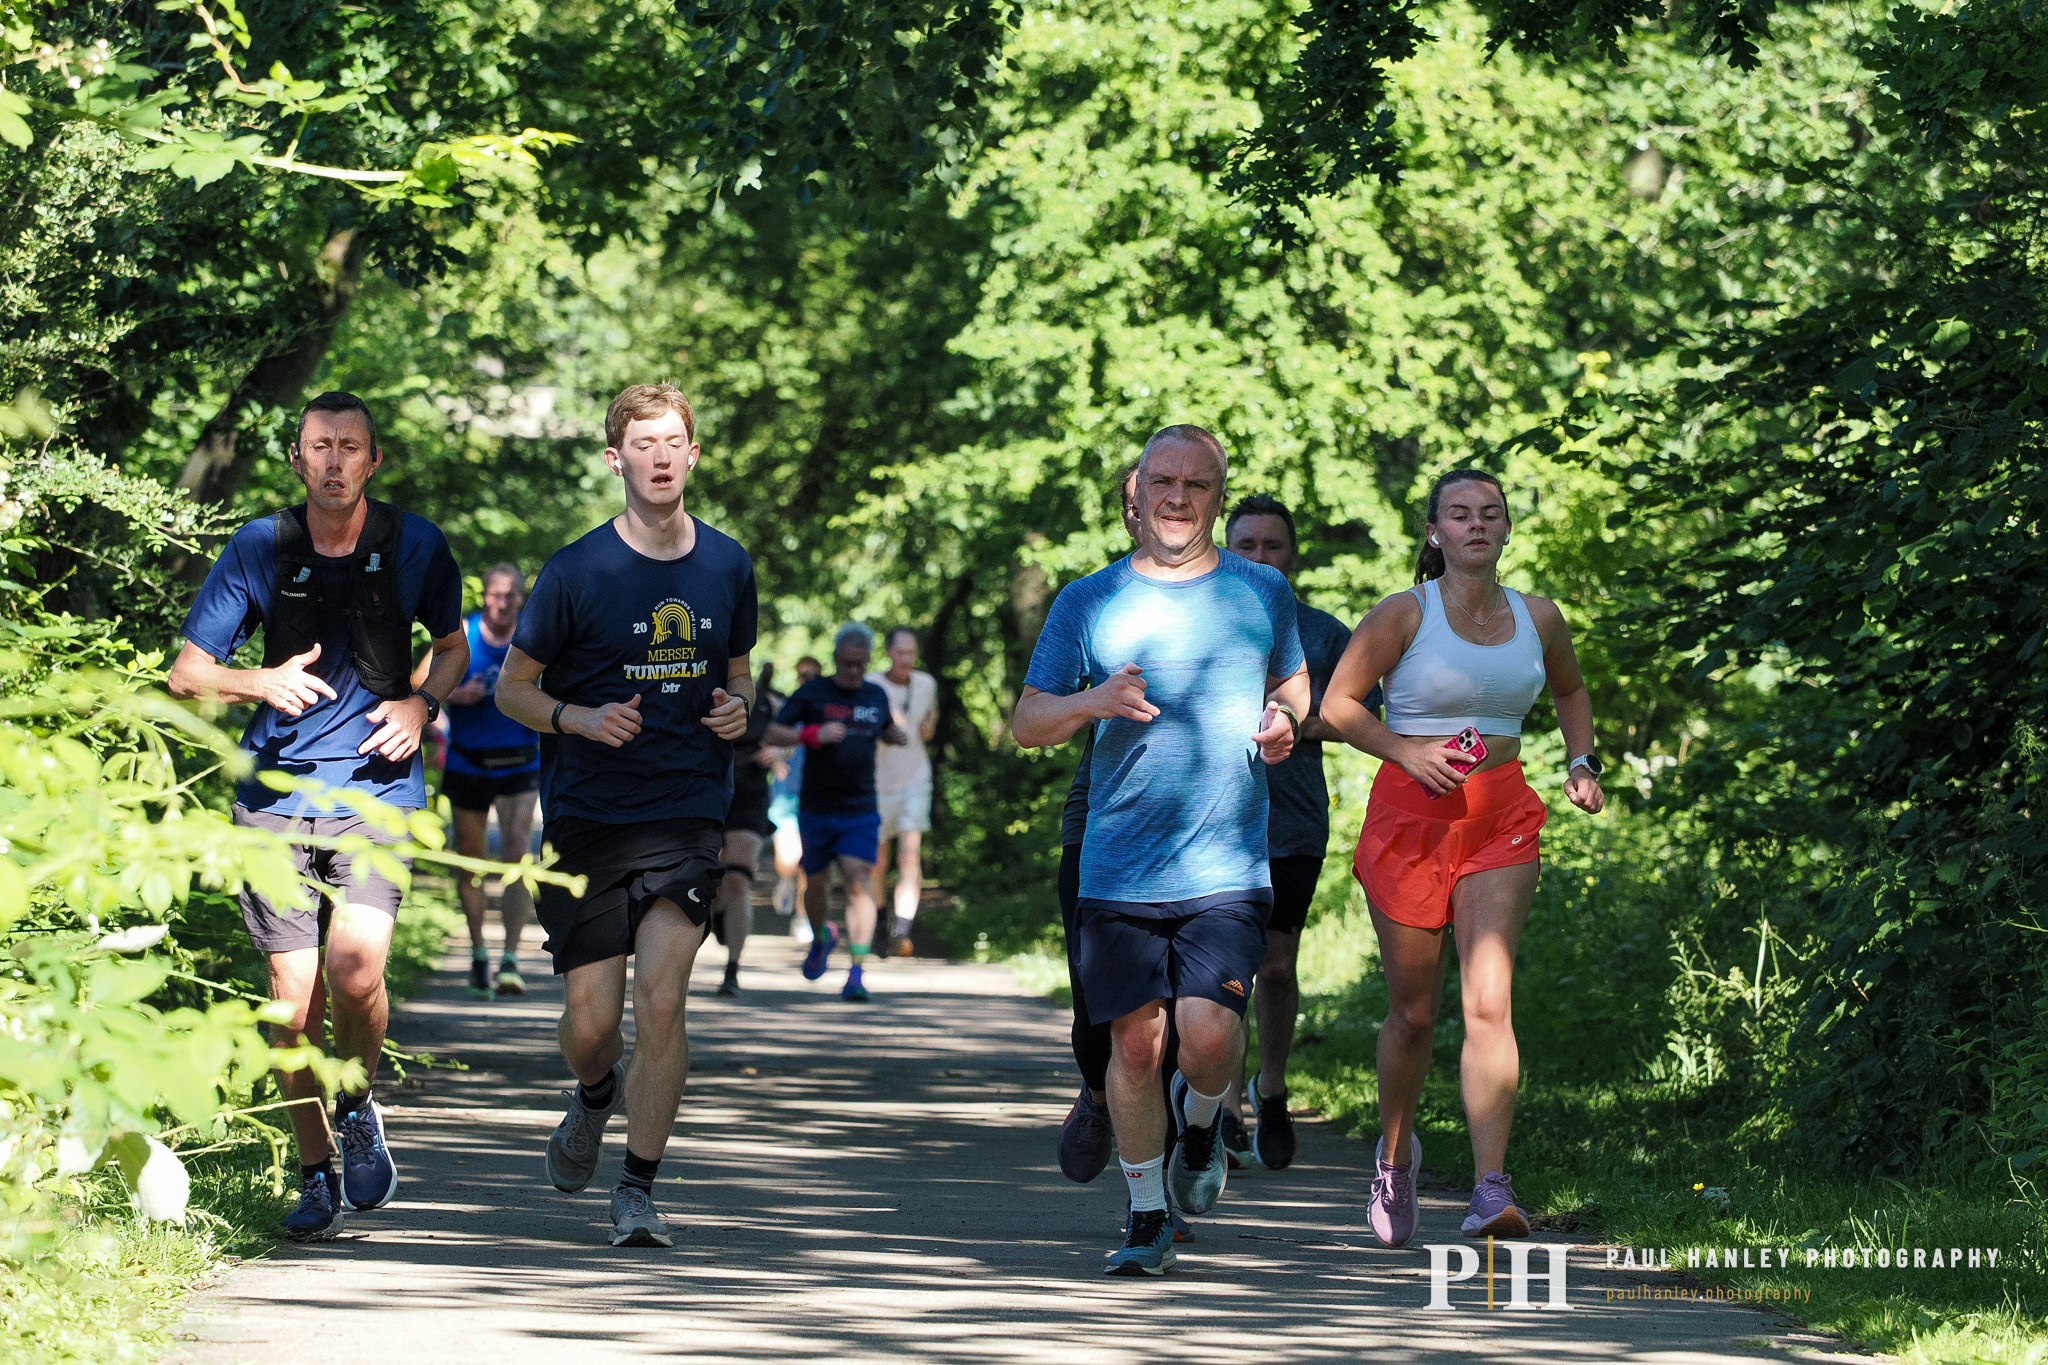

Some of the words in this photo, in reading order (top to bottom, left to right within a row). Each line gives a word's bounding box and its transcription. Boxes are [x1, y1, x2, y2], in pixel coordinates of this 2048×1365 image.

[655, 601, 665, 610] RUN
[666, 598, 690, 610] TOWARDS
[633, 622, 647, 634] 20
[700, 618, 712, 629] 26
[648, 647, 696, 662] MERSEY
[624, 663, 691, 680] TUNNEL
